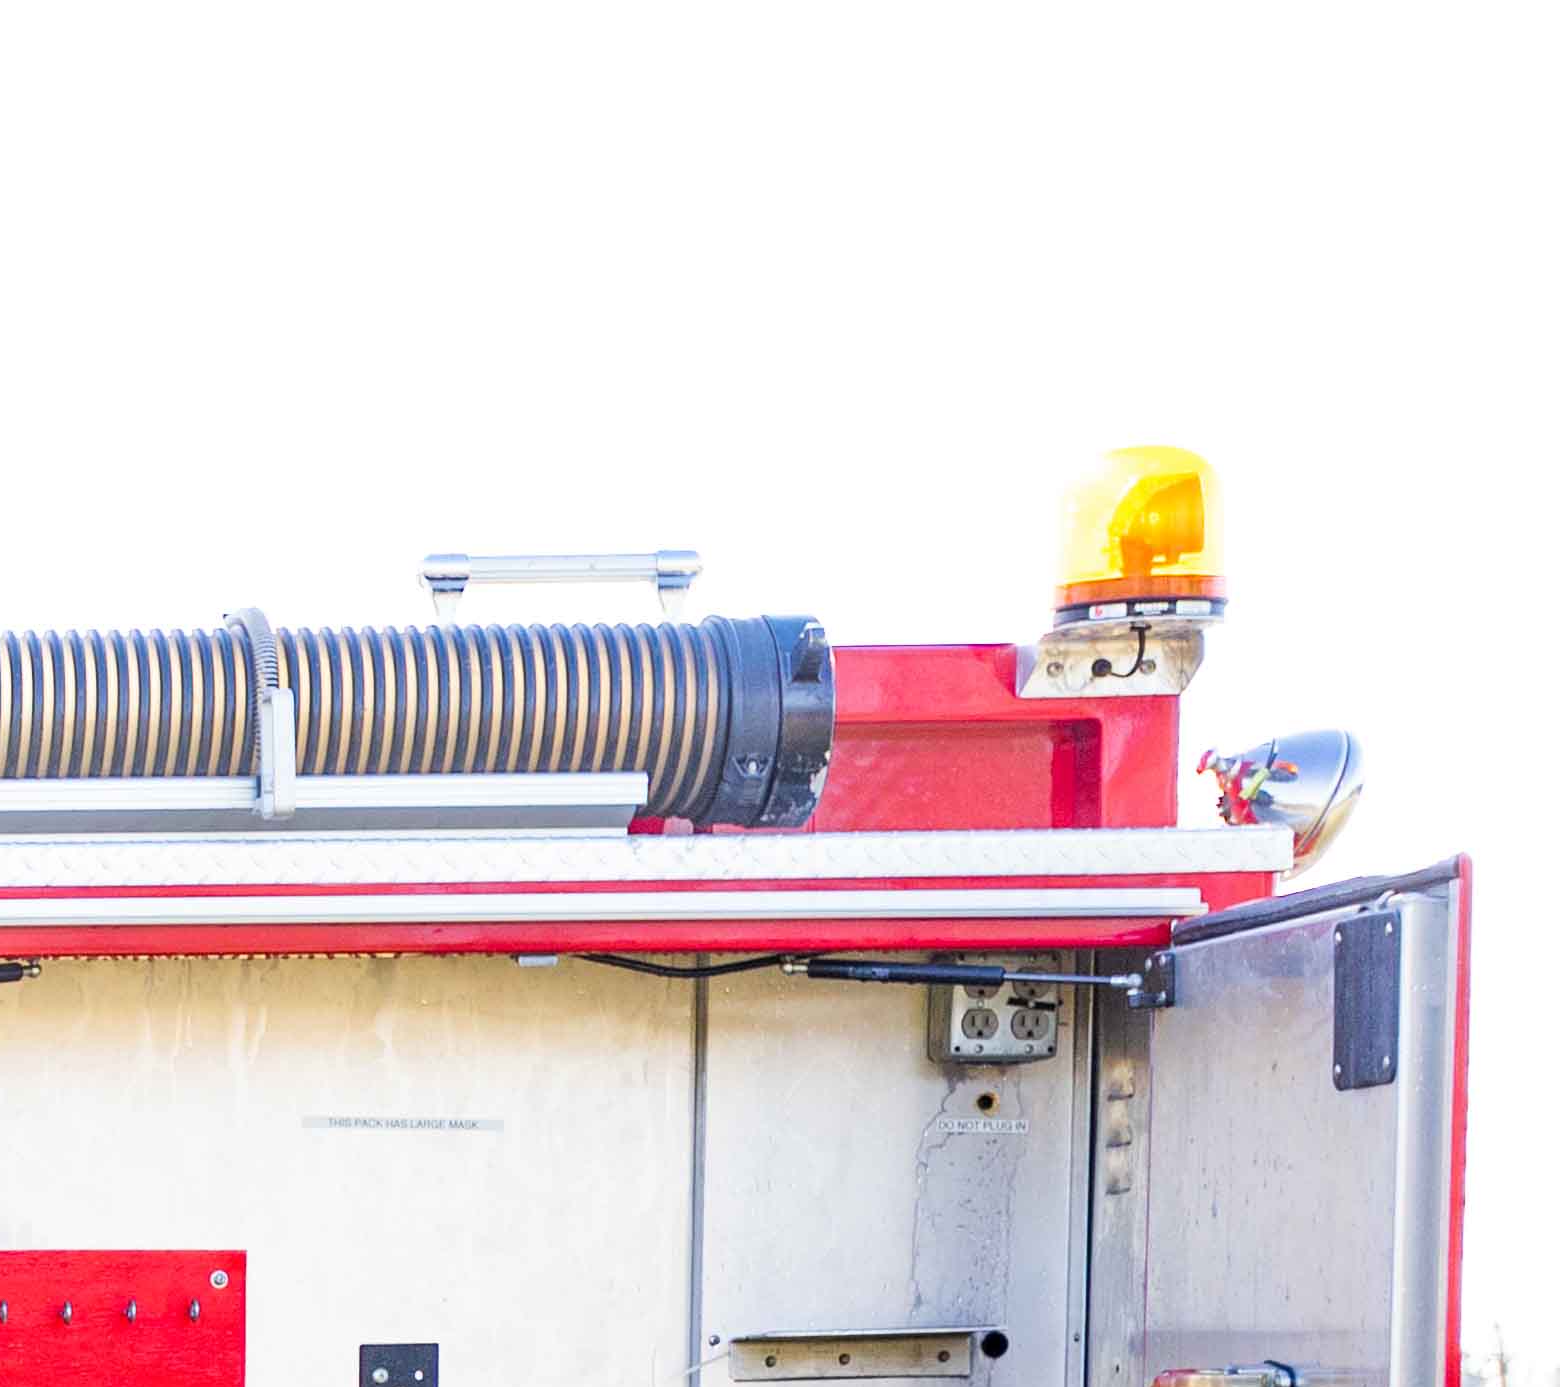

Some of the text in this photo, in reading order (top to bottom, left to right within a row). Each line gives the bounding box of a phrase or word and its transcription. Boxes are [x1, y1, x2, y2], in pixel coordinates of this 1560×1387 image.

[328, 1119, 479, 1129] THIS PACK HAS LARGE MASK
[938, 1120, 1026, 1129] DO NOT PLUG IN
